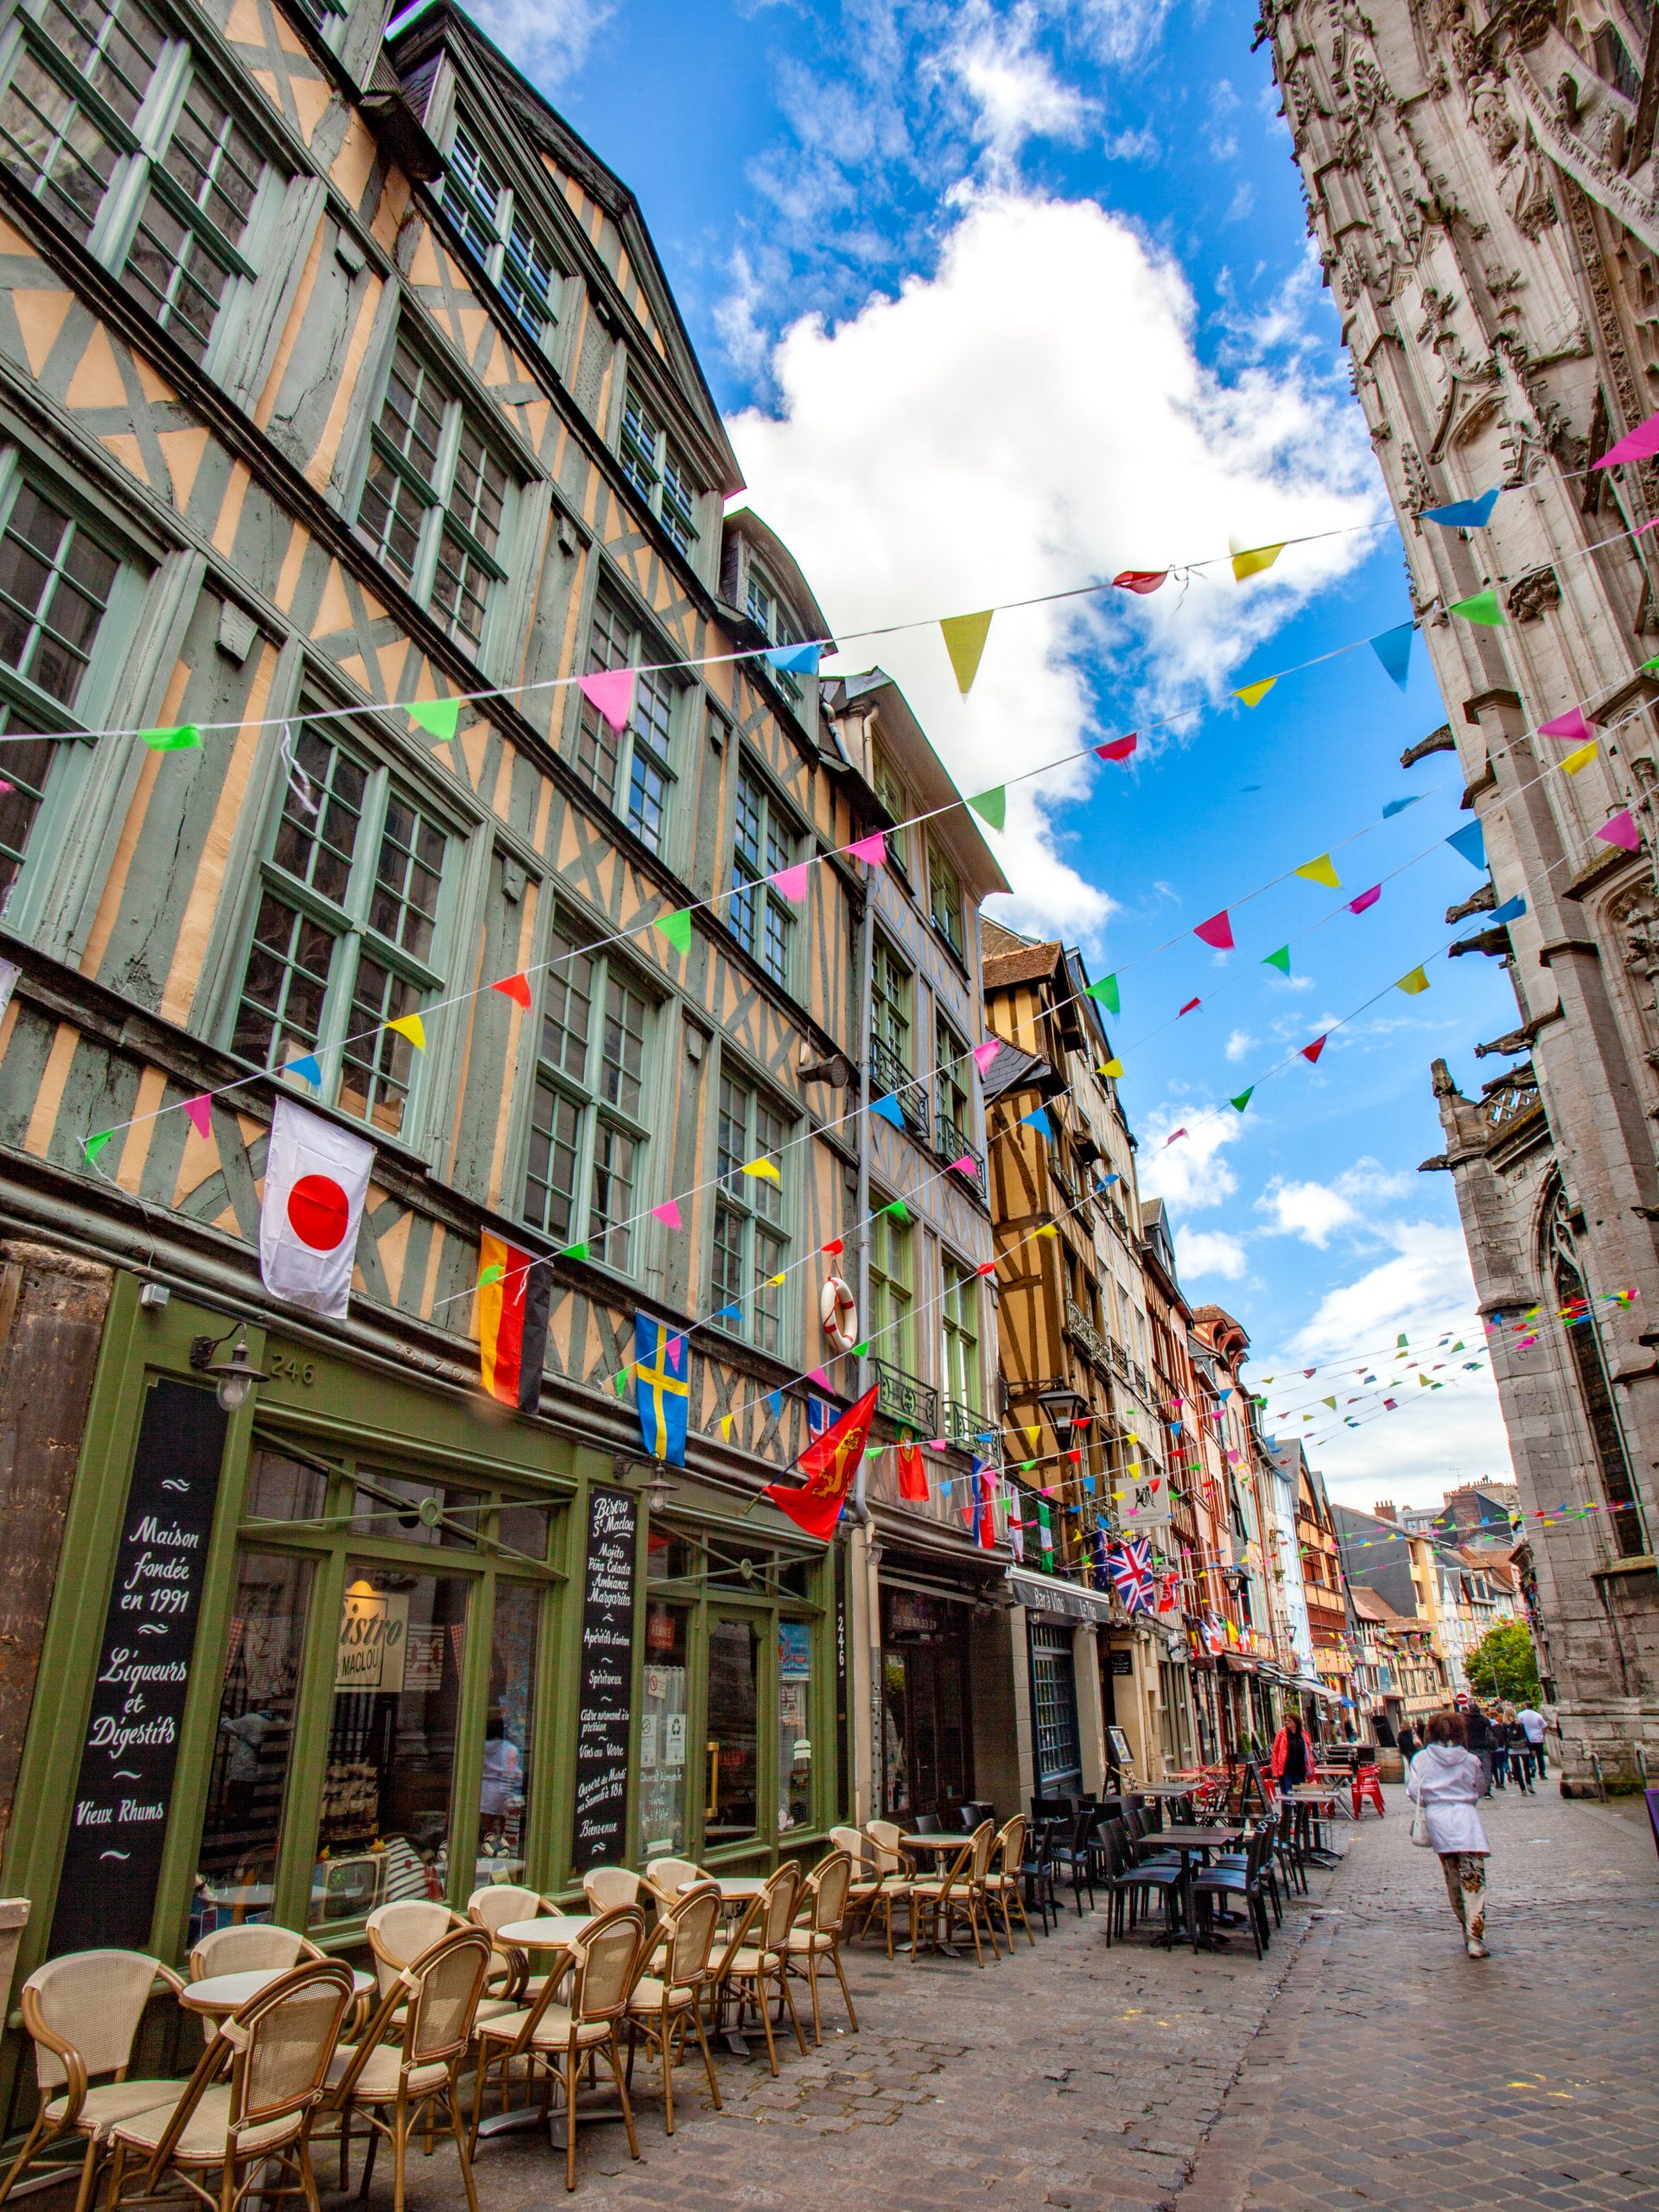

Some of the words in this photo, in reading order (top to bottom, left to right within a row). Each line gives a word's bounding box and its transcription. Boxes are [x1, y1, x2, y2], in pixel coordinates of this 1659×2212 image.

[268, 1354, 315, 1385] 246
[594, 1497, 628, 1521] Bistro
[129, 1516, 199, 1548] Maison
[593, 1520, 603, 1538] St
[603, 1515, 634, 1533] Maclou
[598, 1542, 625, 1561] Mojito
[124, 1552, 190, 1590] fondée
[588, 1556, 605, 1572] Piña
[607, 1560, 631, 1575] Colada
[592, 1573, 629, 1591] Ambiance
[121, 1592, 143, 1611] en
[149, 1588, 190, 1613] 1991
[588, 1587, 632, 1608] Margarita
[1033, 1587, 1046, 1608] Bar
[1046, 1590, 1051, 1609] à
[1051, 1591, 1065, 1613] Vins
[1078, 1599, 1087, 1618] Le
[1085, 1600, 1097, 1619] Trio
[340, 1599, 404, 1647] istro
[584, 1627, 611, 1649] Apéritifs
[99, 1647, 188, 1694] Liqueurs
[341, 1647, 379, 1677] MACLOU
[588, 1669, 622, 1689] Spiritueux
[124, 1693, 146, 1713] et
[597, 1708, 621, 1721] normand
[89, 1716, 175, 1759] Digestifs
[582, 1721, 607, 1738] pression
[579, 1744, 594, 1758] Vins
[594, 1748, 604, 1758] au
[607, 1742, 624, 1757] Verre
[578, 1776, 601, 1798] Ouvert
[608, 1767, 627, 1782] Mardi
[585, 1786, 605, 1808] Samedi
[76, 1800, 114, 1826] Vieux
[118, 1798, 164, 1822] Rhums
[579, 1819, 618, 1838] Bienvenue
